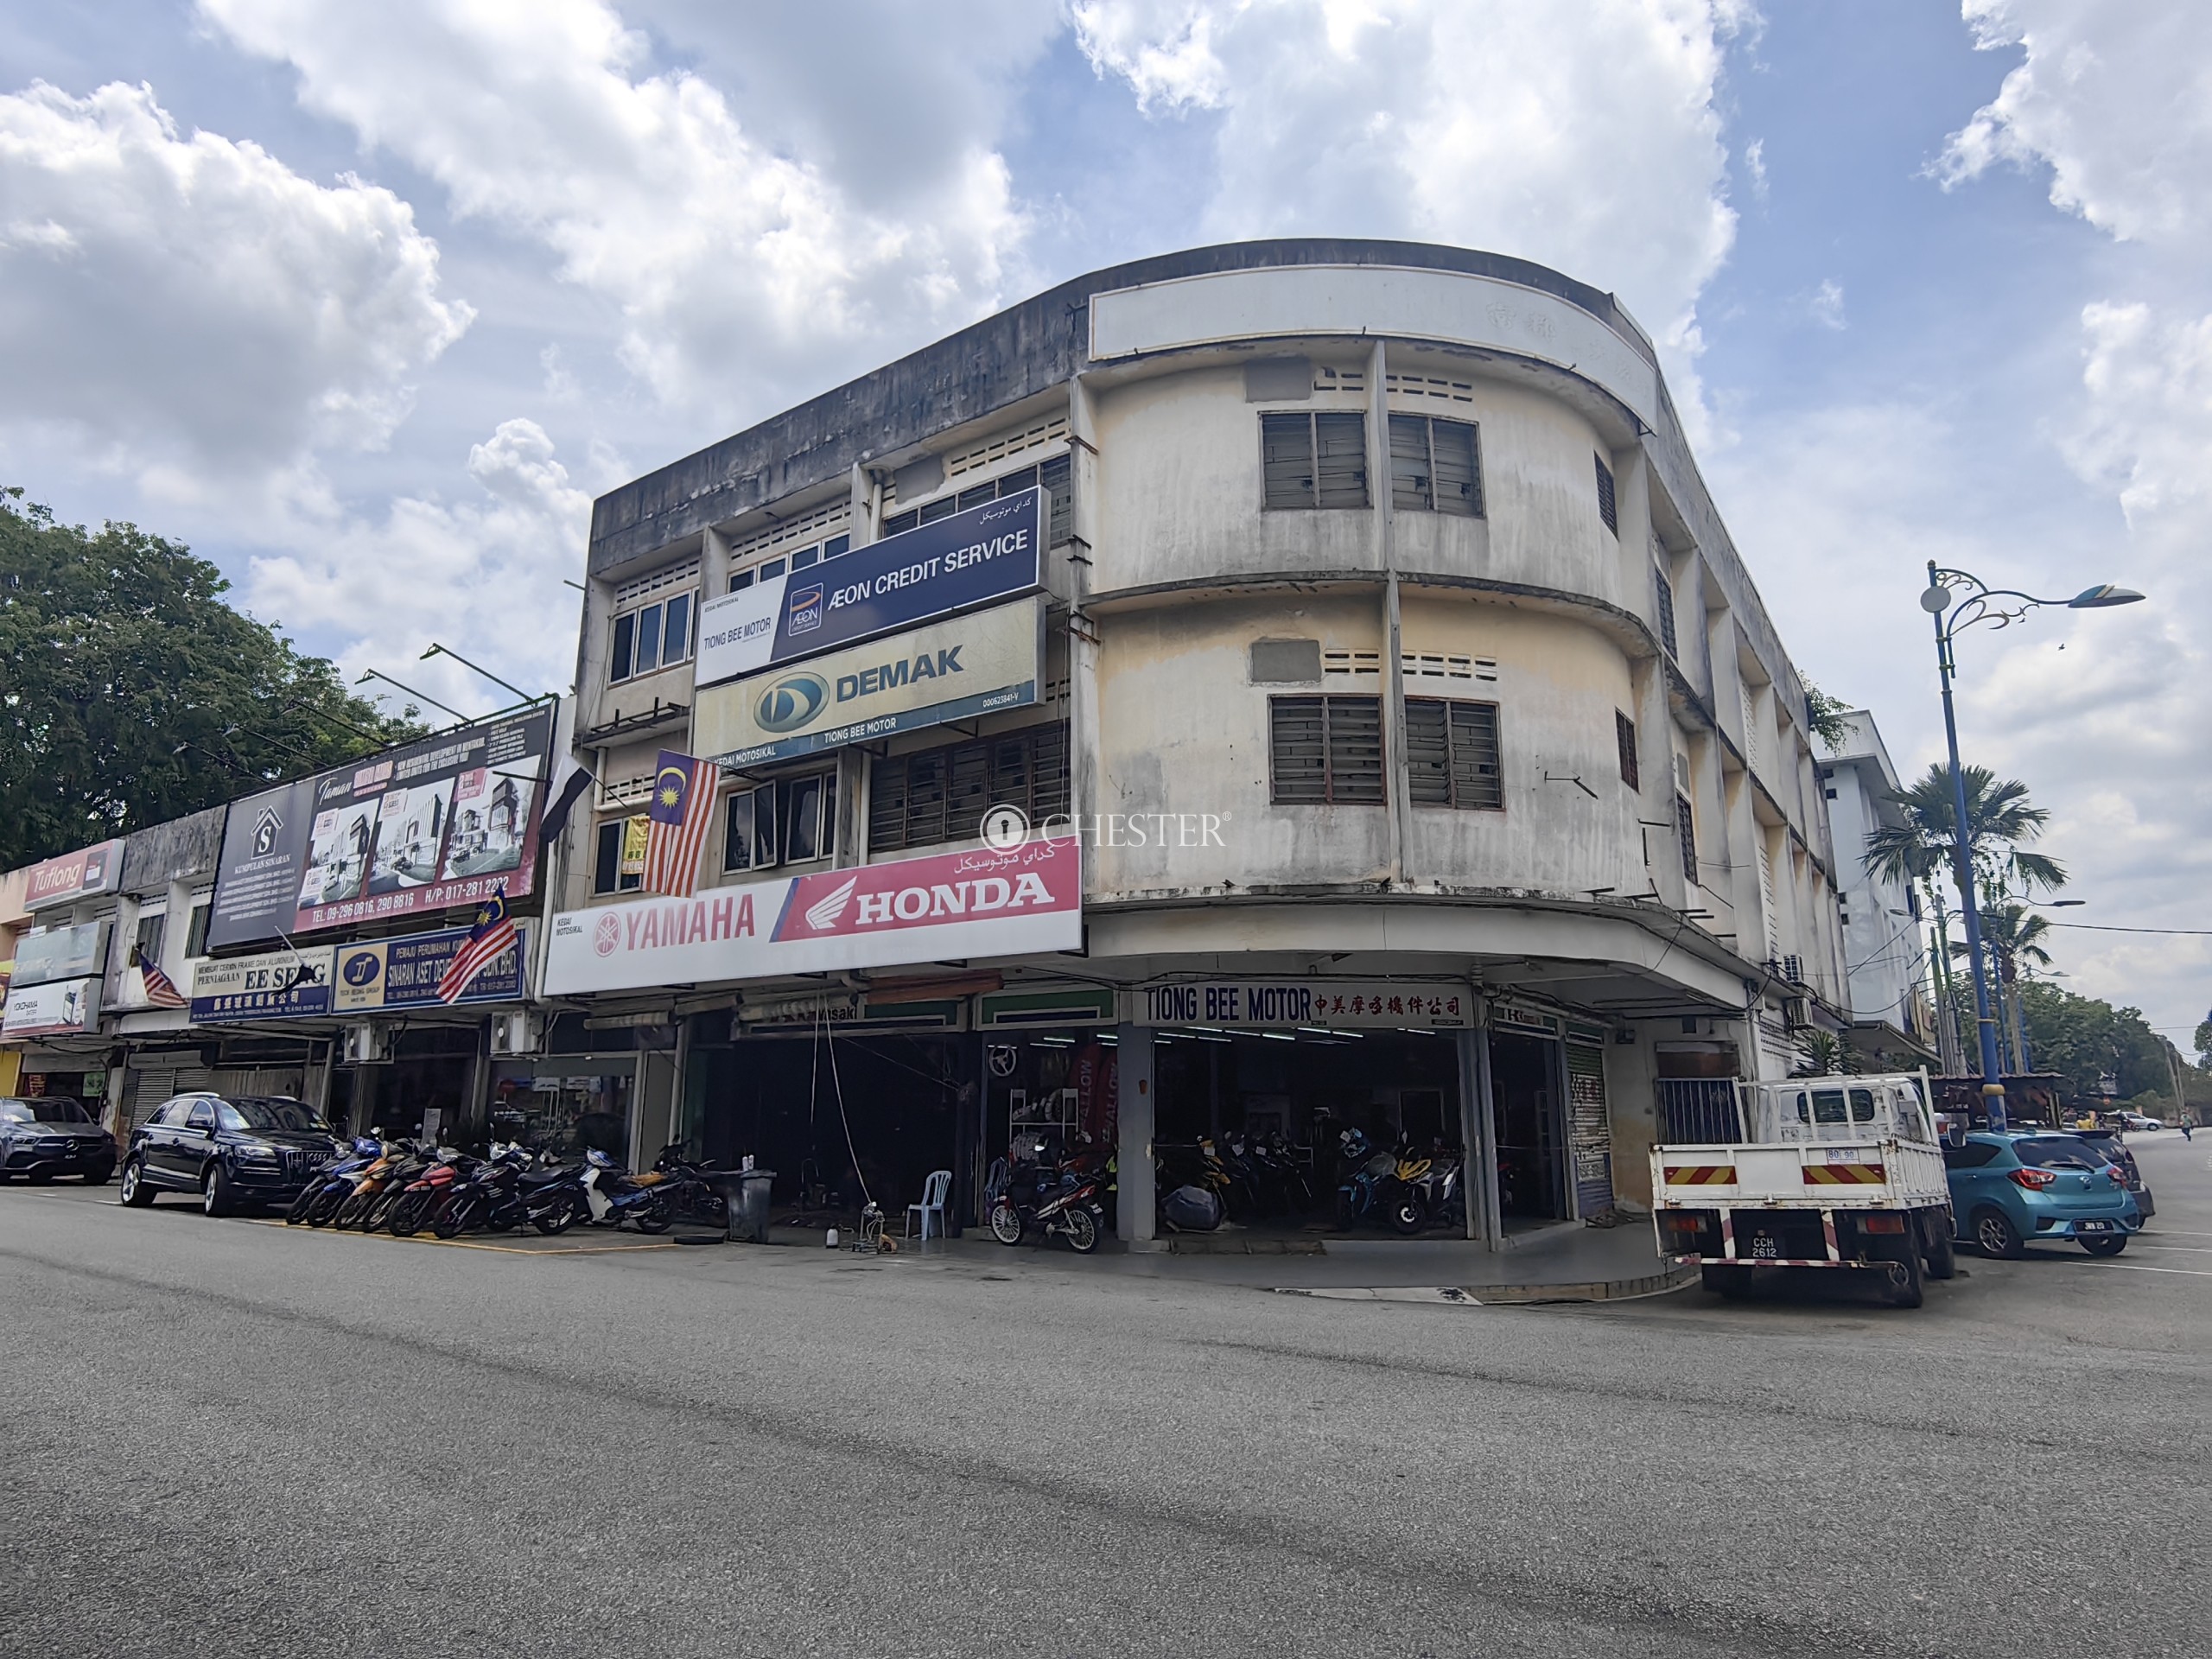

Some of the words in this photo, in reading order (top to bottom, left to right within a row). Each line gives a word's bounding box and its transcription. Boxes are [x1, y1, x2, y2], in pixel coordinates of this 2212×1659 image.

[874, 556, 941, 594] CREDIT
[944, 529, 1028, 573] SERVICE
[704, 632, 727, 651] TIONG
[727, 627, 742, 644] BEE
[743, 617, 772, 638] MOTOR
[836, 645, 964, 703] DEMAK
[823, 728, 849, 743] TIONG
[849, 724, 866, 739] BEE
[867, 717, 897, 734] MOTOR
[735, 747, 777, 766] MOTOSIKAL
[318, 777, 353, 806] Taman
[258, 825, 272, 853] S
[34, 863, 81, 893] Tuflong
[445, 879, 483, 899] 017-281
[377, 897, 392, 912] 290
[392, 892, 415, 908] 8816
[855, 872, 1056, 925] HONDA
[556, 917, 572, 927] KEDAI
[556, 925, 583, 936] MOTOSIKAL
[626, 893, 755, 950] YAMAHA
[245, 969, 270, 990] EE
[272, 963, 326, 988] SEG
[388, 961, 415, 988] SINARAN
[416, 958, 433, 984] ASET
[1144, 987, 1198, 1021] TIONG
[1205, 987, 1240, 1021] BEE
[1248, 987, 1312, 1021] MOTOR
[1828, 1149, 1840, 1159] 80
[1751, 1248, 1777, 1258] 2612
[1753, 1237, 1774, 1248] CCH
